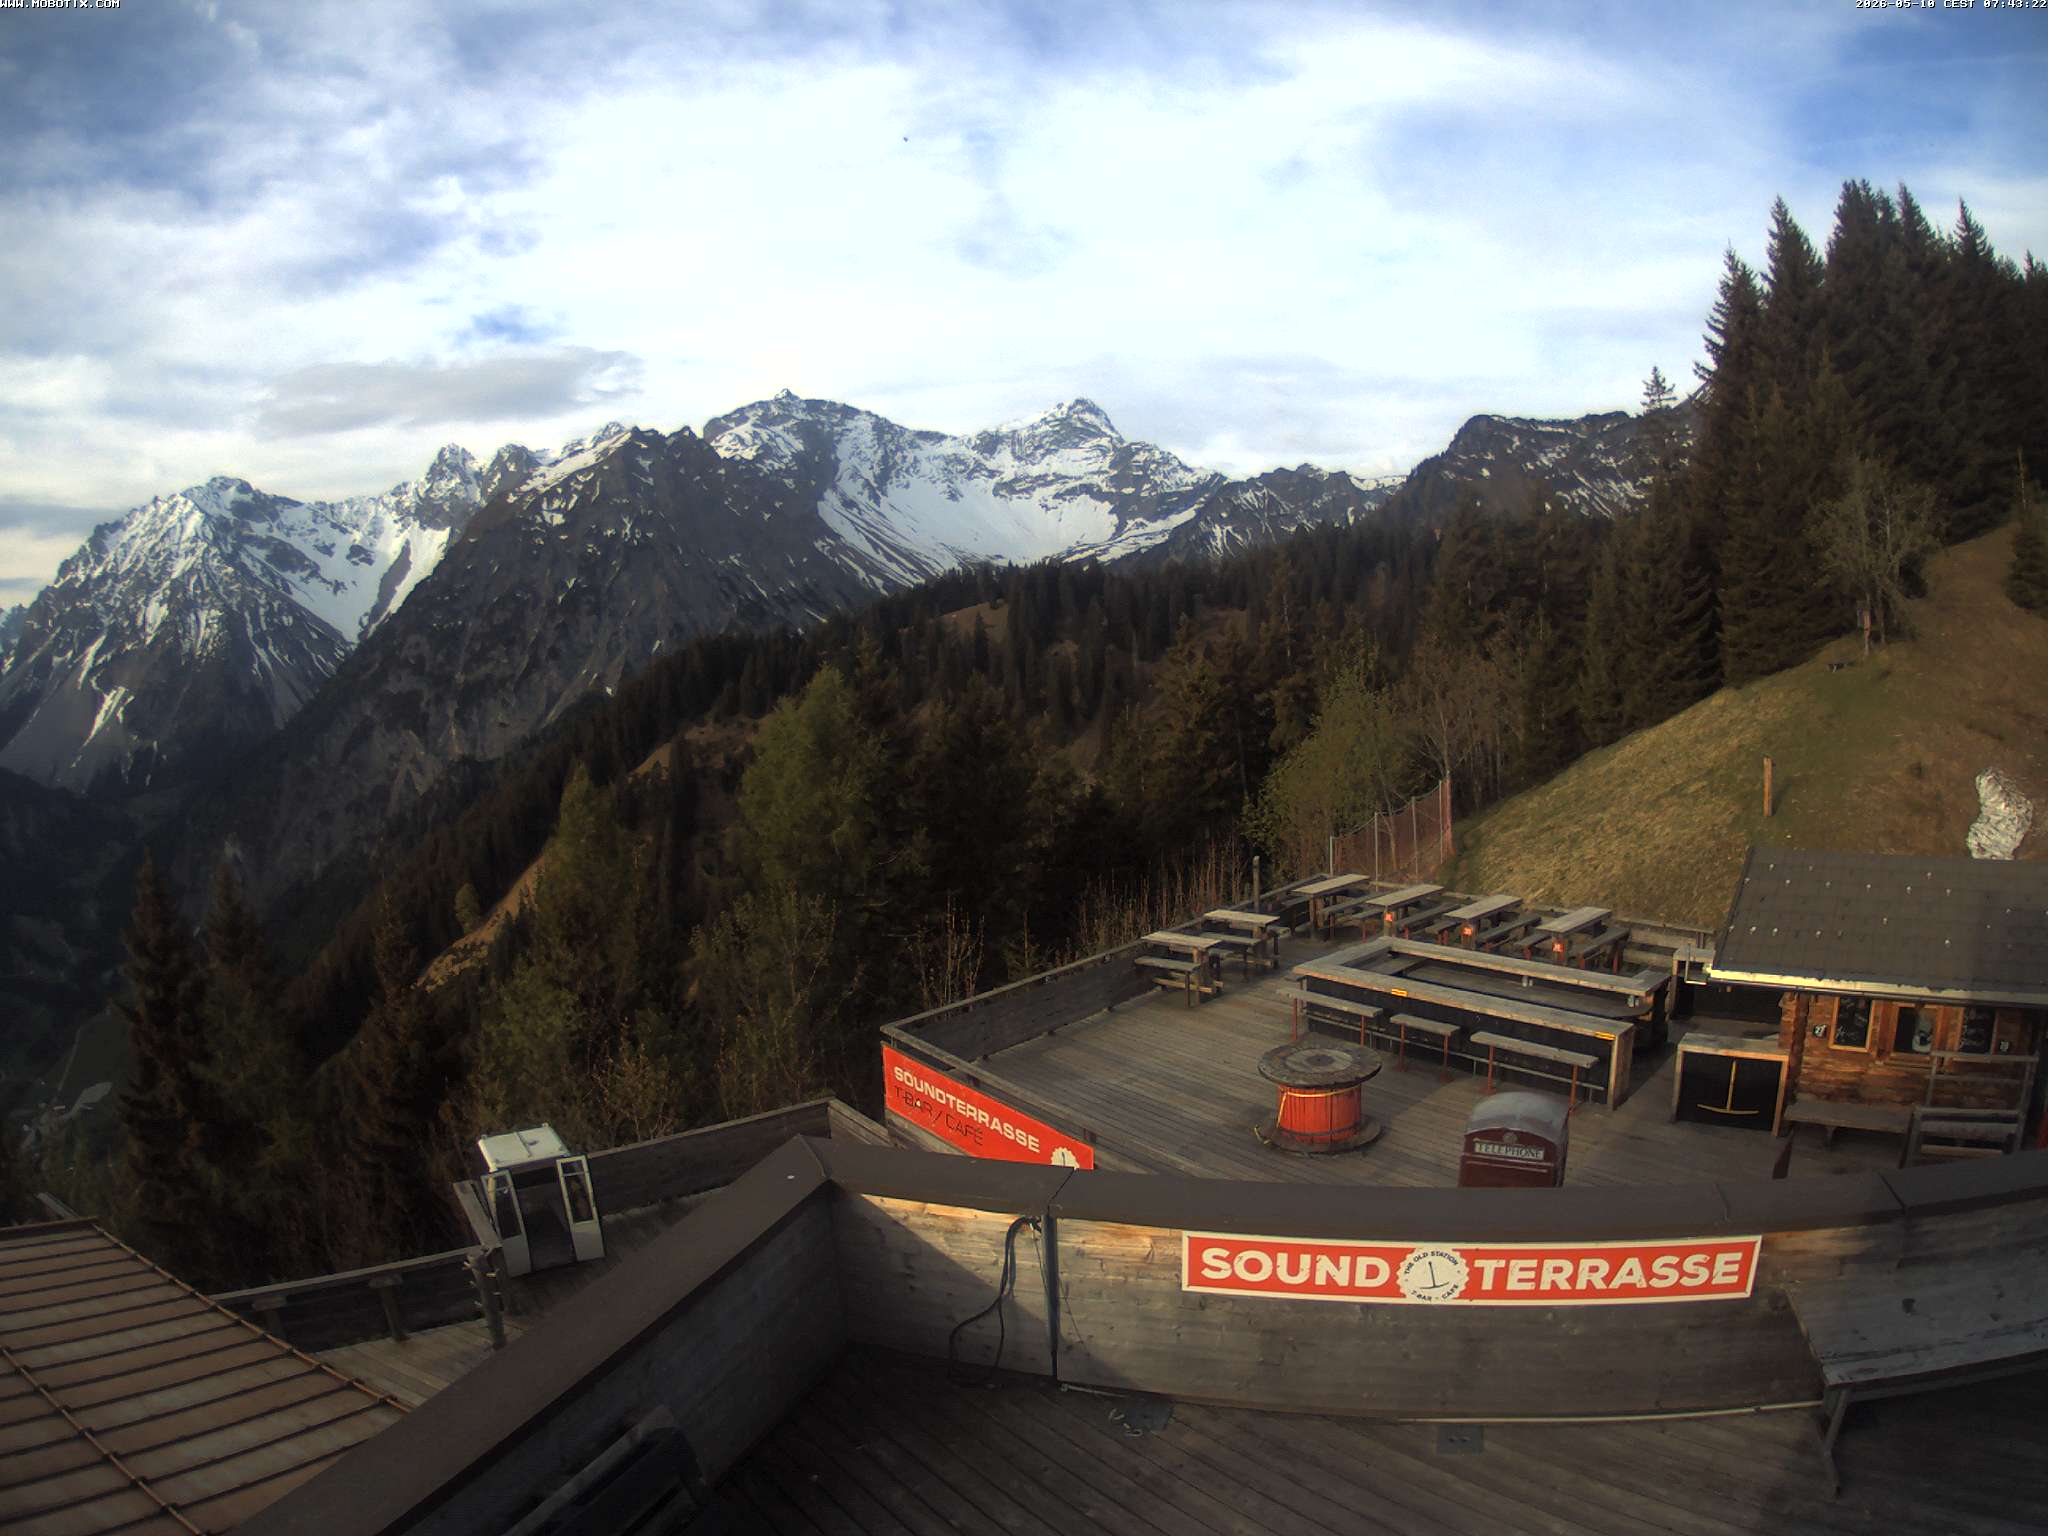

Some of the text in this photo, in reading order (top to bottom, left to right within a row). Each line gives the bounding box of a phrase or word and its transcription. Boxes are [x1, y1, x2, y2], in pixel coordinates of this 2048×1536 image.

[894, 1066, 1041, 1153] SOUNDTERRASSE
[1476, 1143, 1543, 1159] TELEPHONE
[1201, 1248, 1743, 1290] SOUND TERRASSE
[1413, 1252, 1429, 1263] OLD
[1430, 1251, 1458, 1265] STATION
